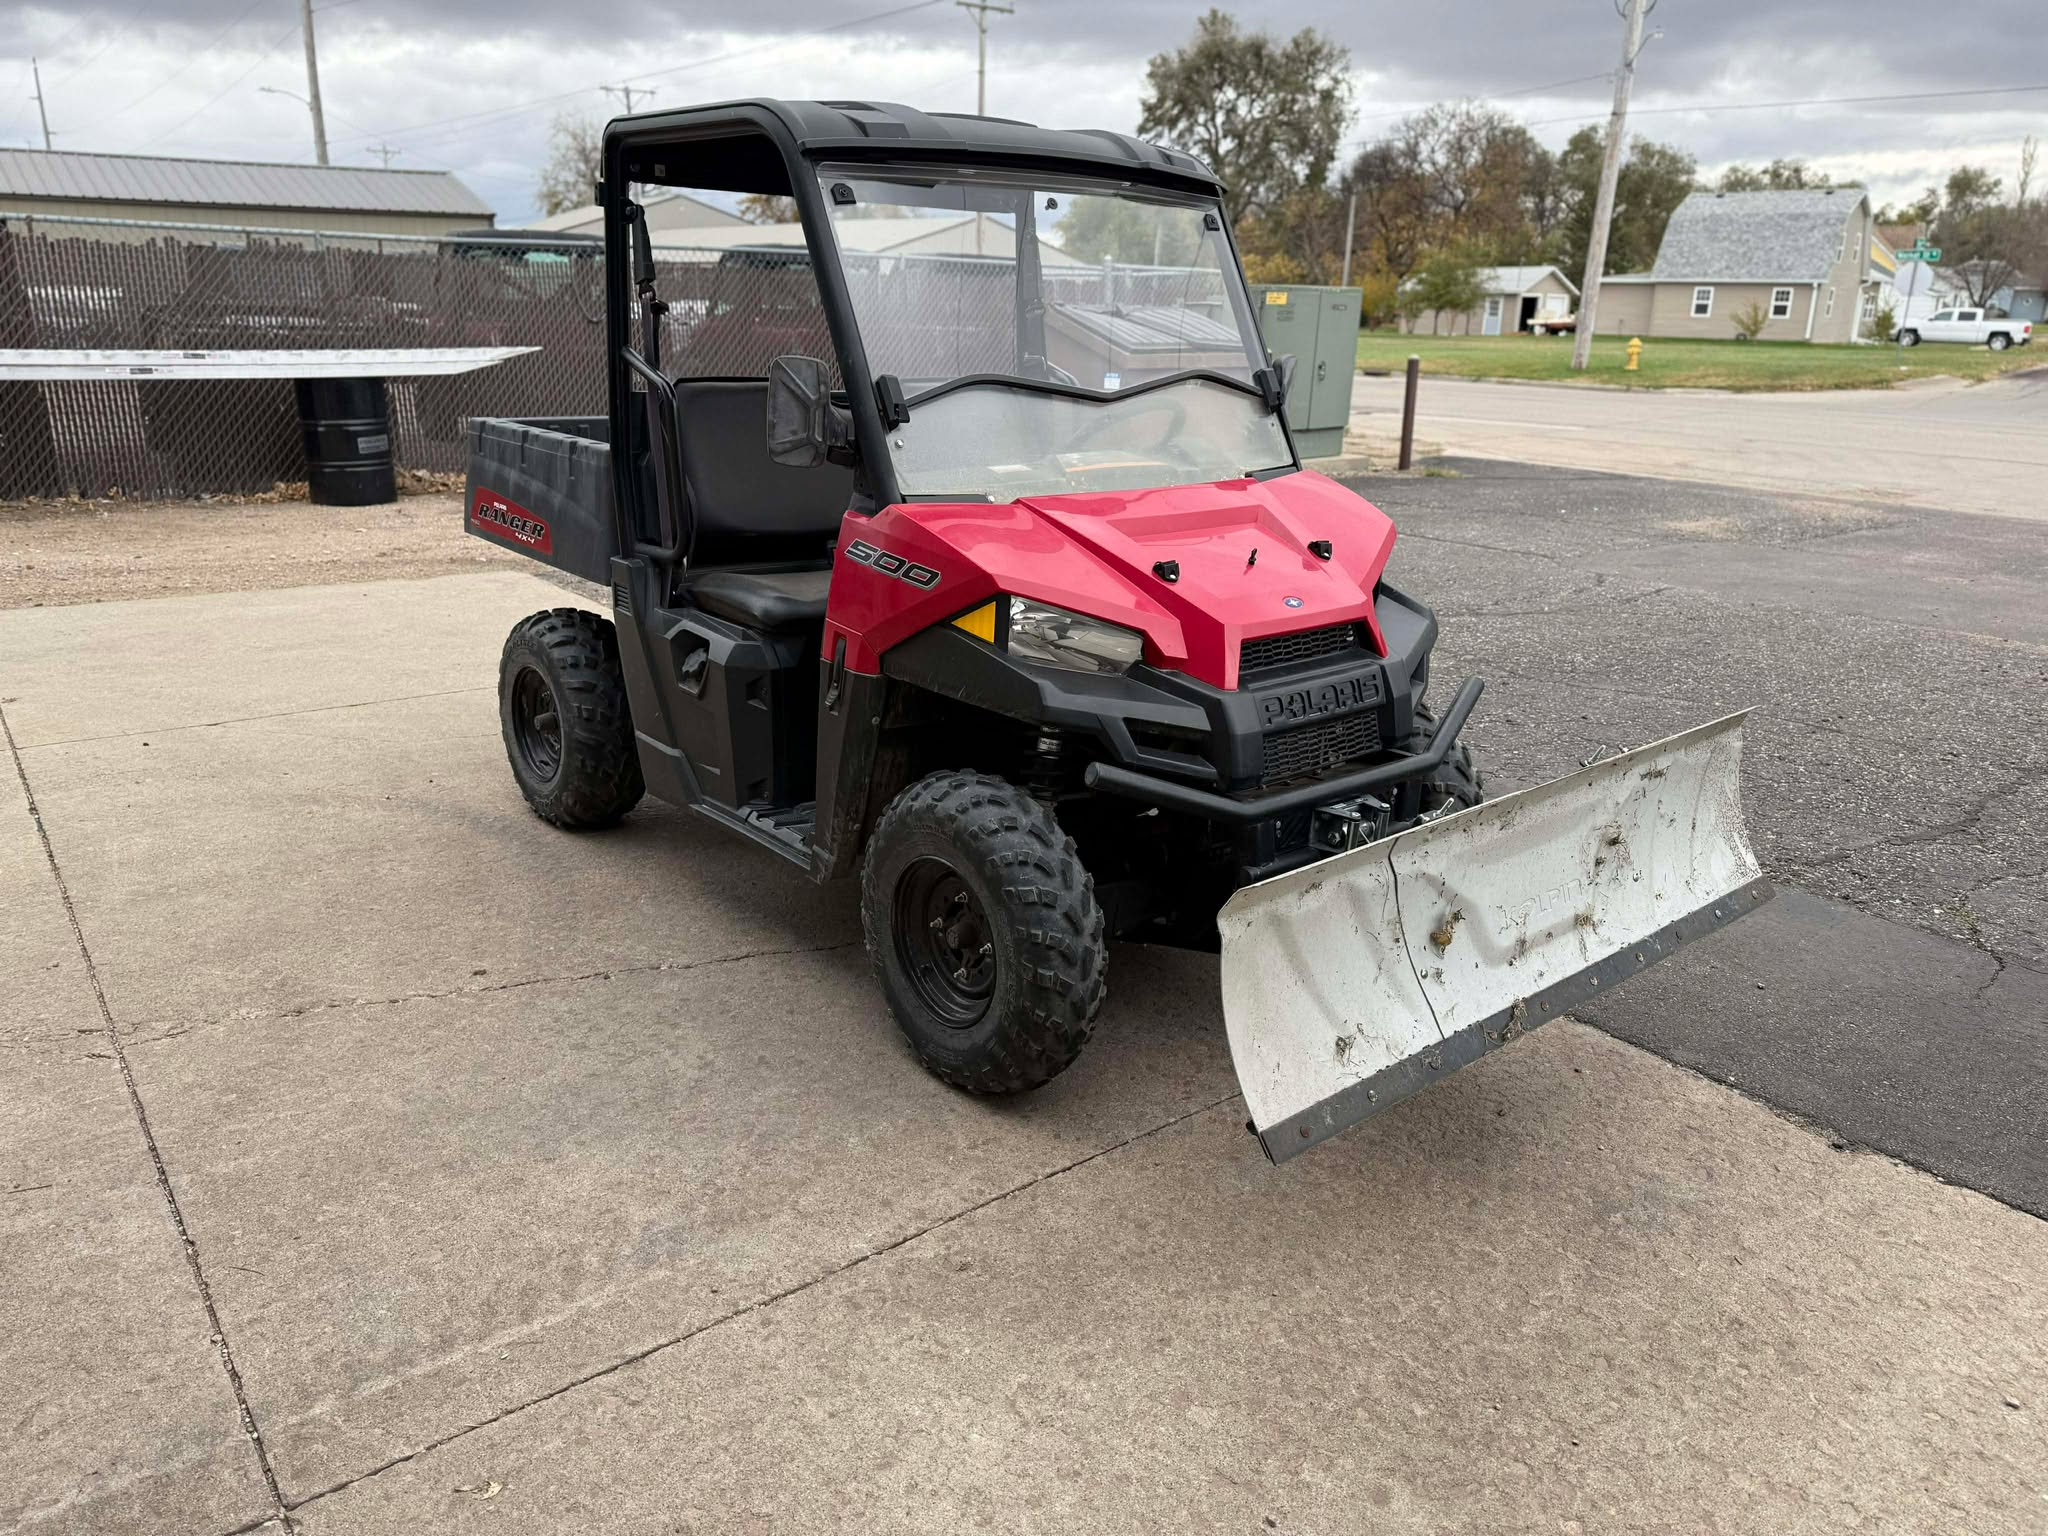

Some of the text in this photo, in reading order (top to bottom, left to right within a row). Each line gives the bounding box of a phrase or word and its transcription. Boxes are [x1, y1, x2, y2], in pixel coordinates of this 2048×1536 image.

[478, 503, 545, 540] RANGER
[844, 538, 941, 591] 500
[1260, 673, 1379, 727] POLARIS
